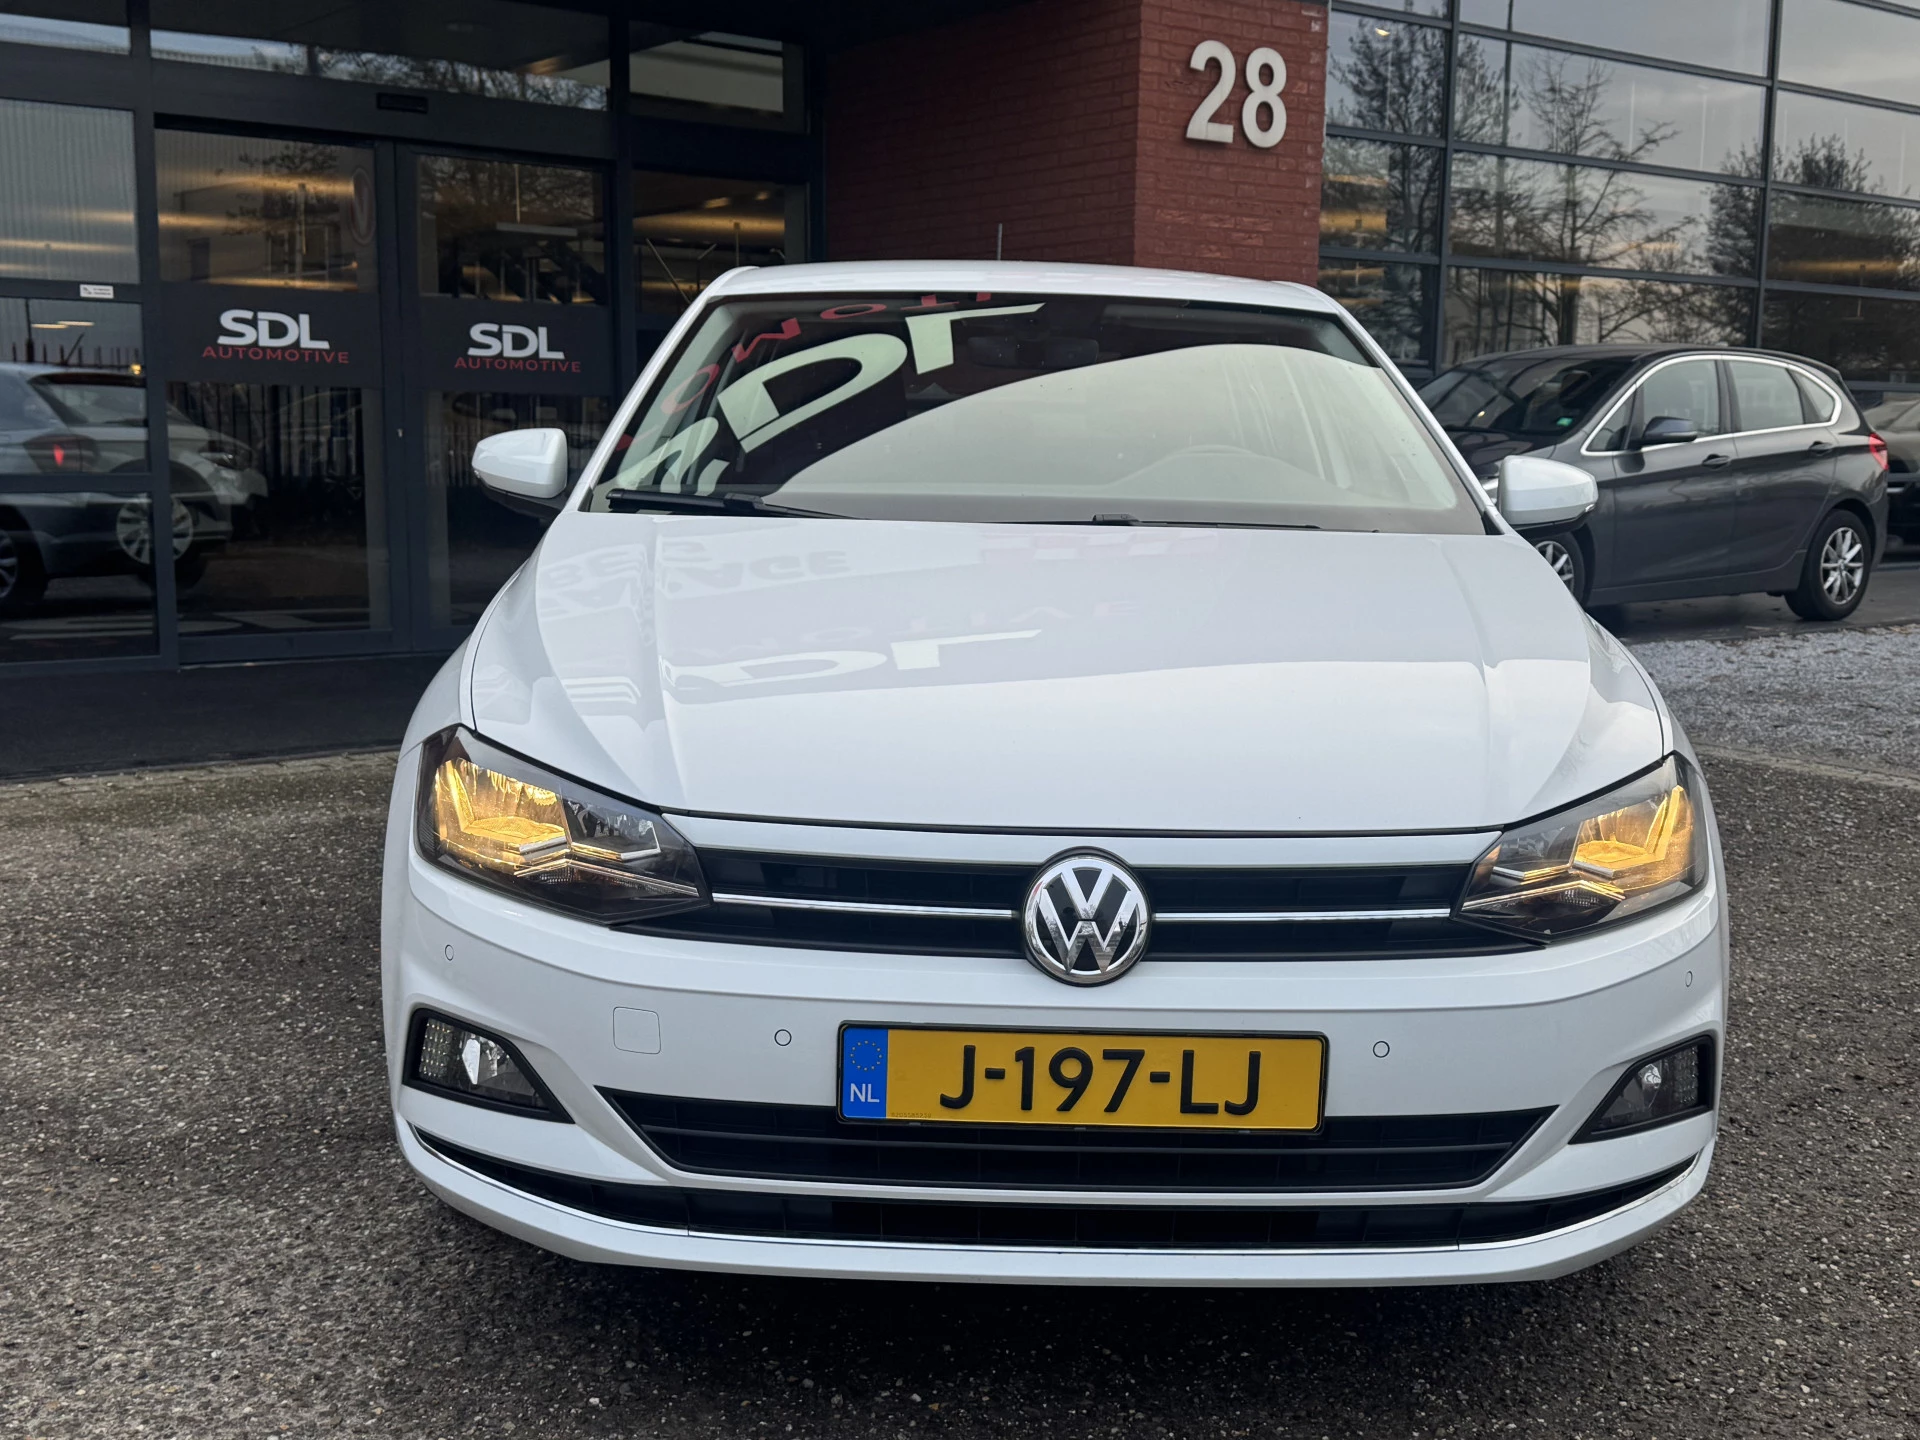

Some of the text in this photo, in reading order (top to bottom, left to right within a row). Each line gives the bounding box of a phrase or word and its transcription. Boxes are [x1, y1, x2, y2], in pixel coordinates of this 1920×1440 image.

[1185, 39, 1288, 149] 28
[217, 308, 330, 349] SDL
[466, 322, 566, 360] SDL
[201, 345, 350, 365] AUTOMOTIVE
[454, 356, 582, 374] AUTOMOTIVE
[850, 1083, 880, 1104] NL
[939, 1044, 1262, 1117] J-197-LJ
